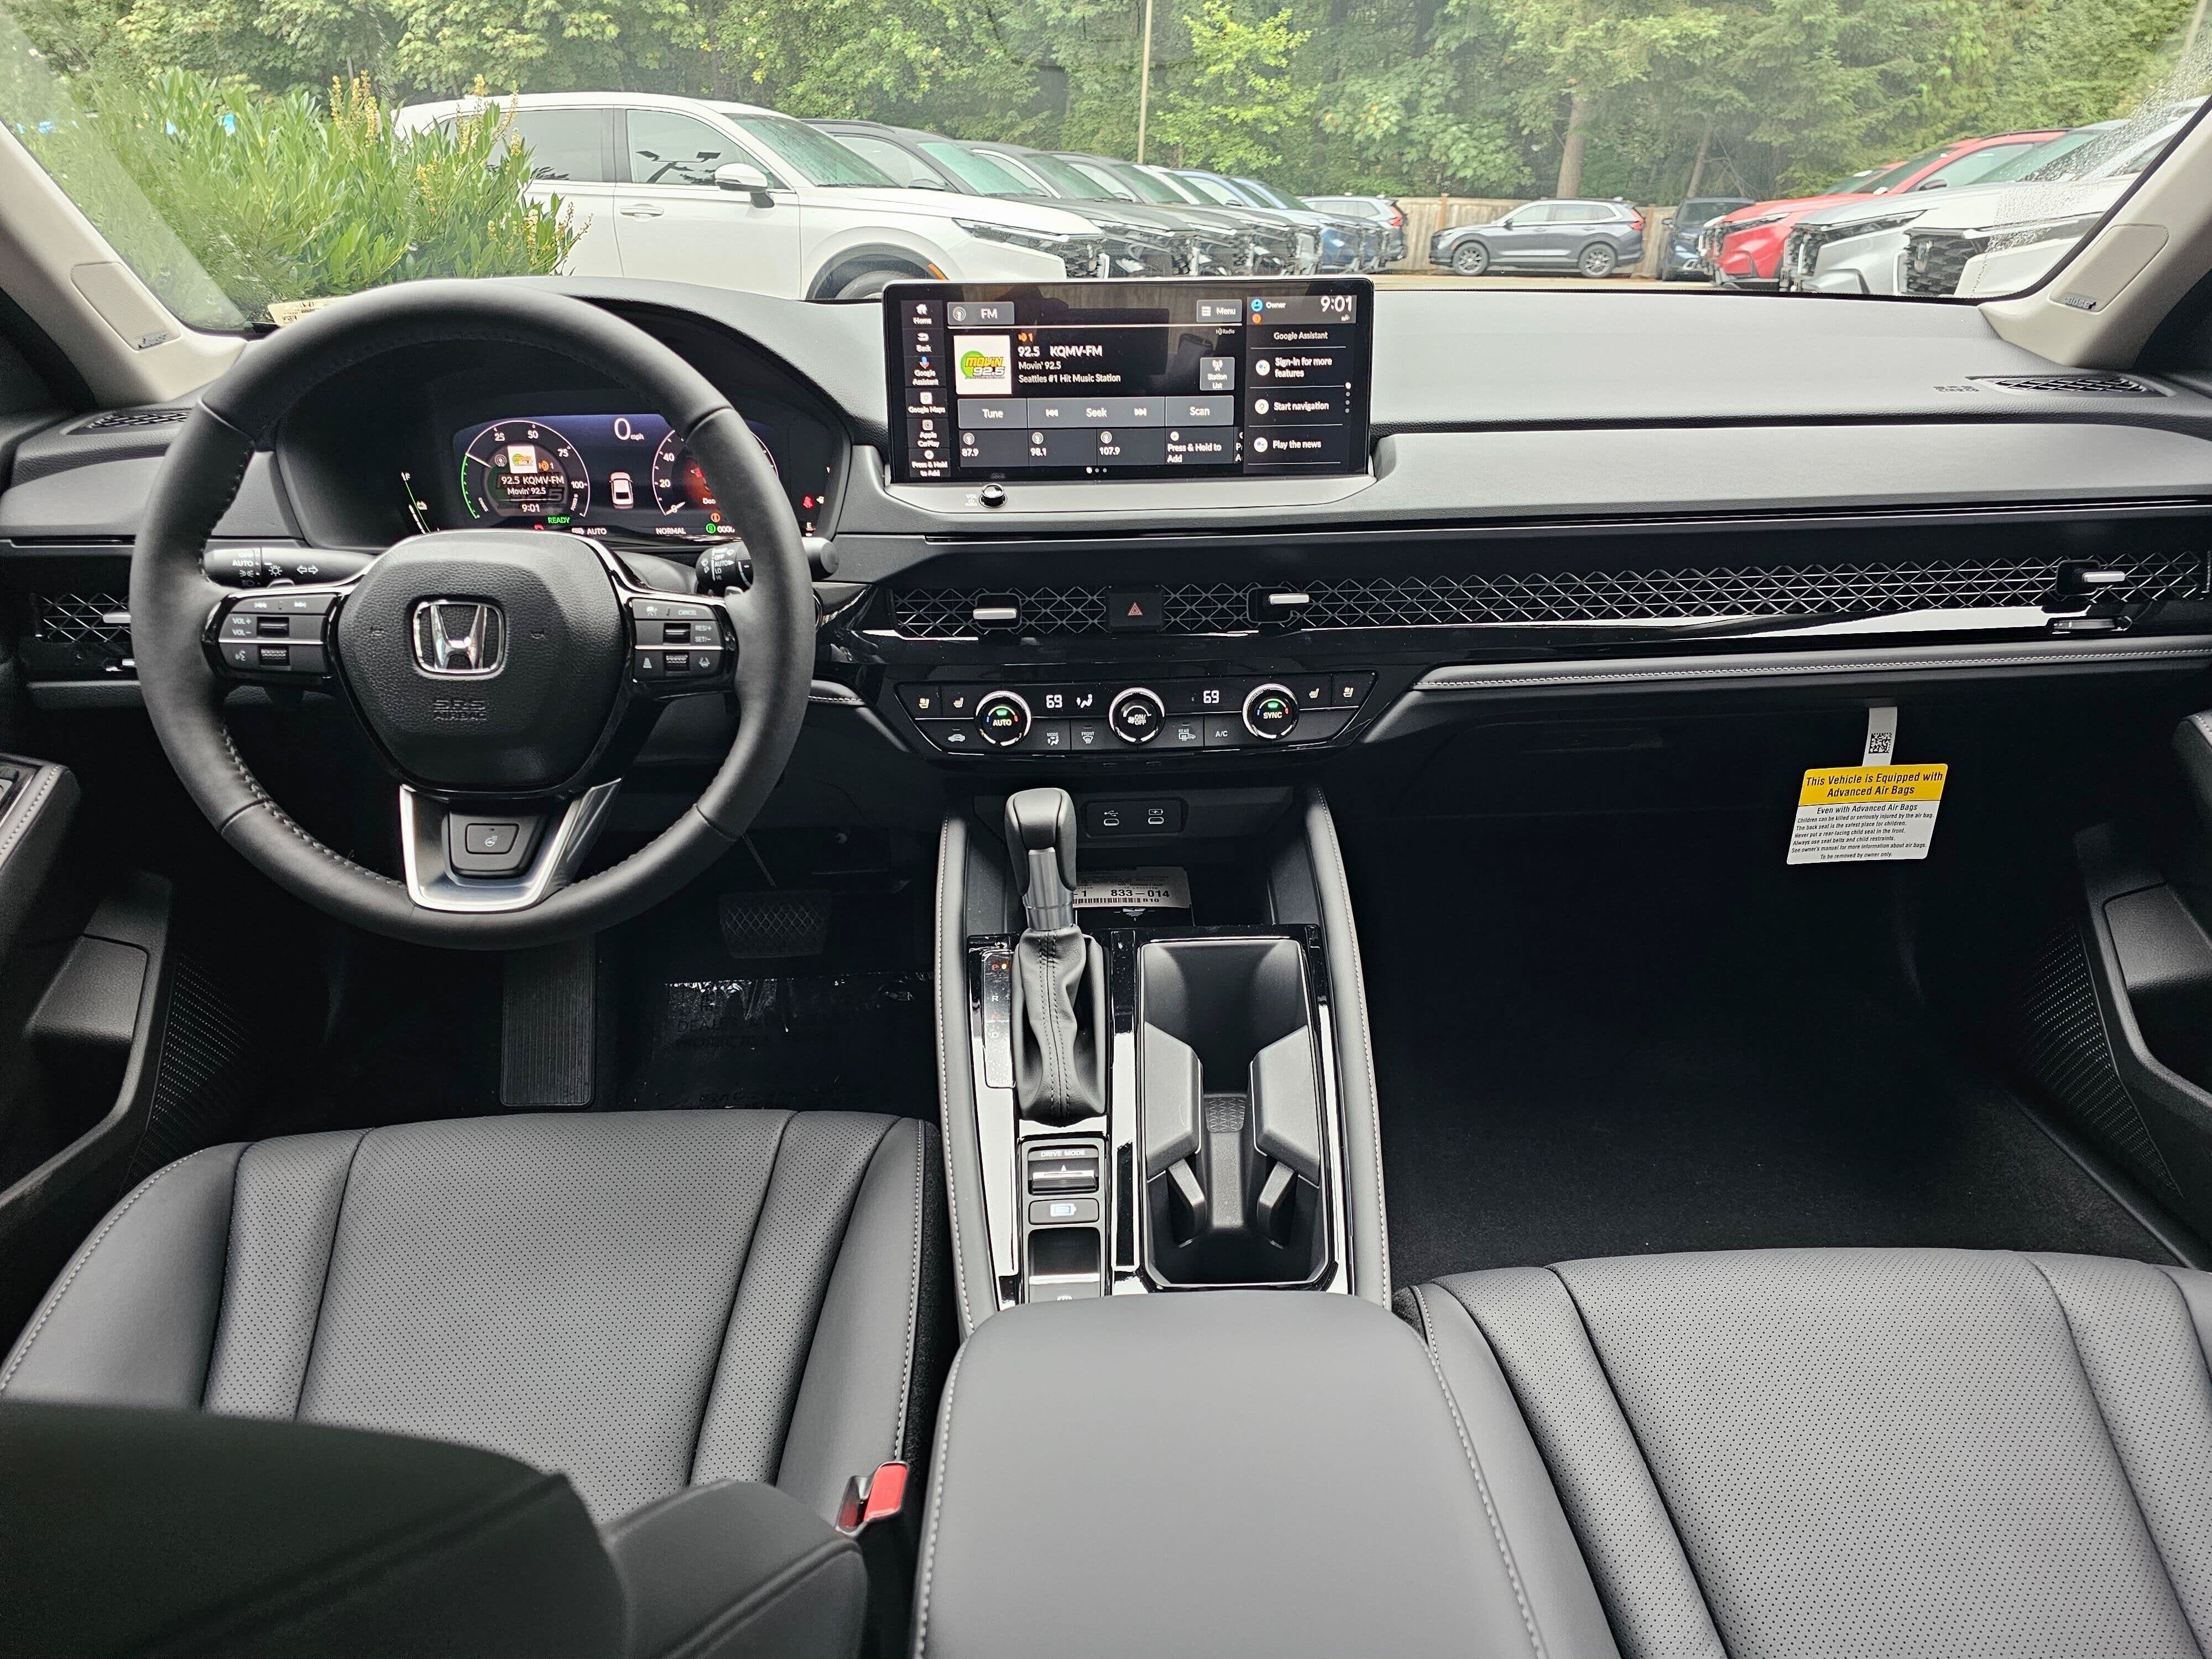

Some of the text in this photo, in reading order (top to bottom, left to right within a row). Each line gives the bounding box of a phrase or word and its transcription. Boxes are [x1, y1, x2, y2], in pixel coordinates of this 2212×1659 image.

[1321, 295, 1352, 312] 9:01
[981, 309, 998, 319] FM
[1274, 331, 1328, 341] Google Assistant
[1018, 345, 1103, 359] 92.5 KQMV-FM
[1018, 361, 1061, 370] Movin' 92.5
[1275, 357, 1300, 368] Sign-in
[1301, 357, 1312, 366] for
[973, 367, 1005, 377] 92.5
[1275, 369, 1305, 378] features
[1018, 373, 1121, 383] Seattles #1 Hit Music Station
[1190, 406, 1211, 416] Scan
[1274, 401, 1329, 412] Start navigation
[982, 409, 1004, 419] Tune
[1086, 408, 1107, 418] Seek
[528, 430, 539, 439] 50
[614, 418, 631, 441] 0
[494, 433, 505, 441] 25
[1167, 443, 1222, 452] Press & Hold to
[1272, 440, 1288, 450] Play
[1289, 440, 1301, 448] the
[557, 448, 570, 457] 75
[1099, 447, 1120, 455] 107.9
[662, 453, 675, 462] 40
[1167, 454, 1182, 463] Add
[523, 476, 565, 485] KQMV-FM
[571, 481, 585, 489] 100
[659, 479, 670, 488] 20
[521, 504, 540, 513] 9:01
[1046, 694, 1063, 709] 69
[1203, 690, 1219, 703] 69
[1807, 771, 1943, 786] This Vehicle is Equipped with
[1827, 786, 1915, 797] Advanced Air Bags
[1851, 804, 1886, 812] Advanced
[1900, 804, 1918, 812] Bags
